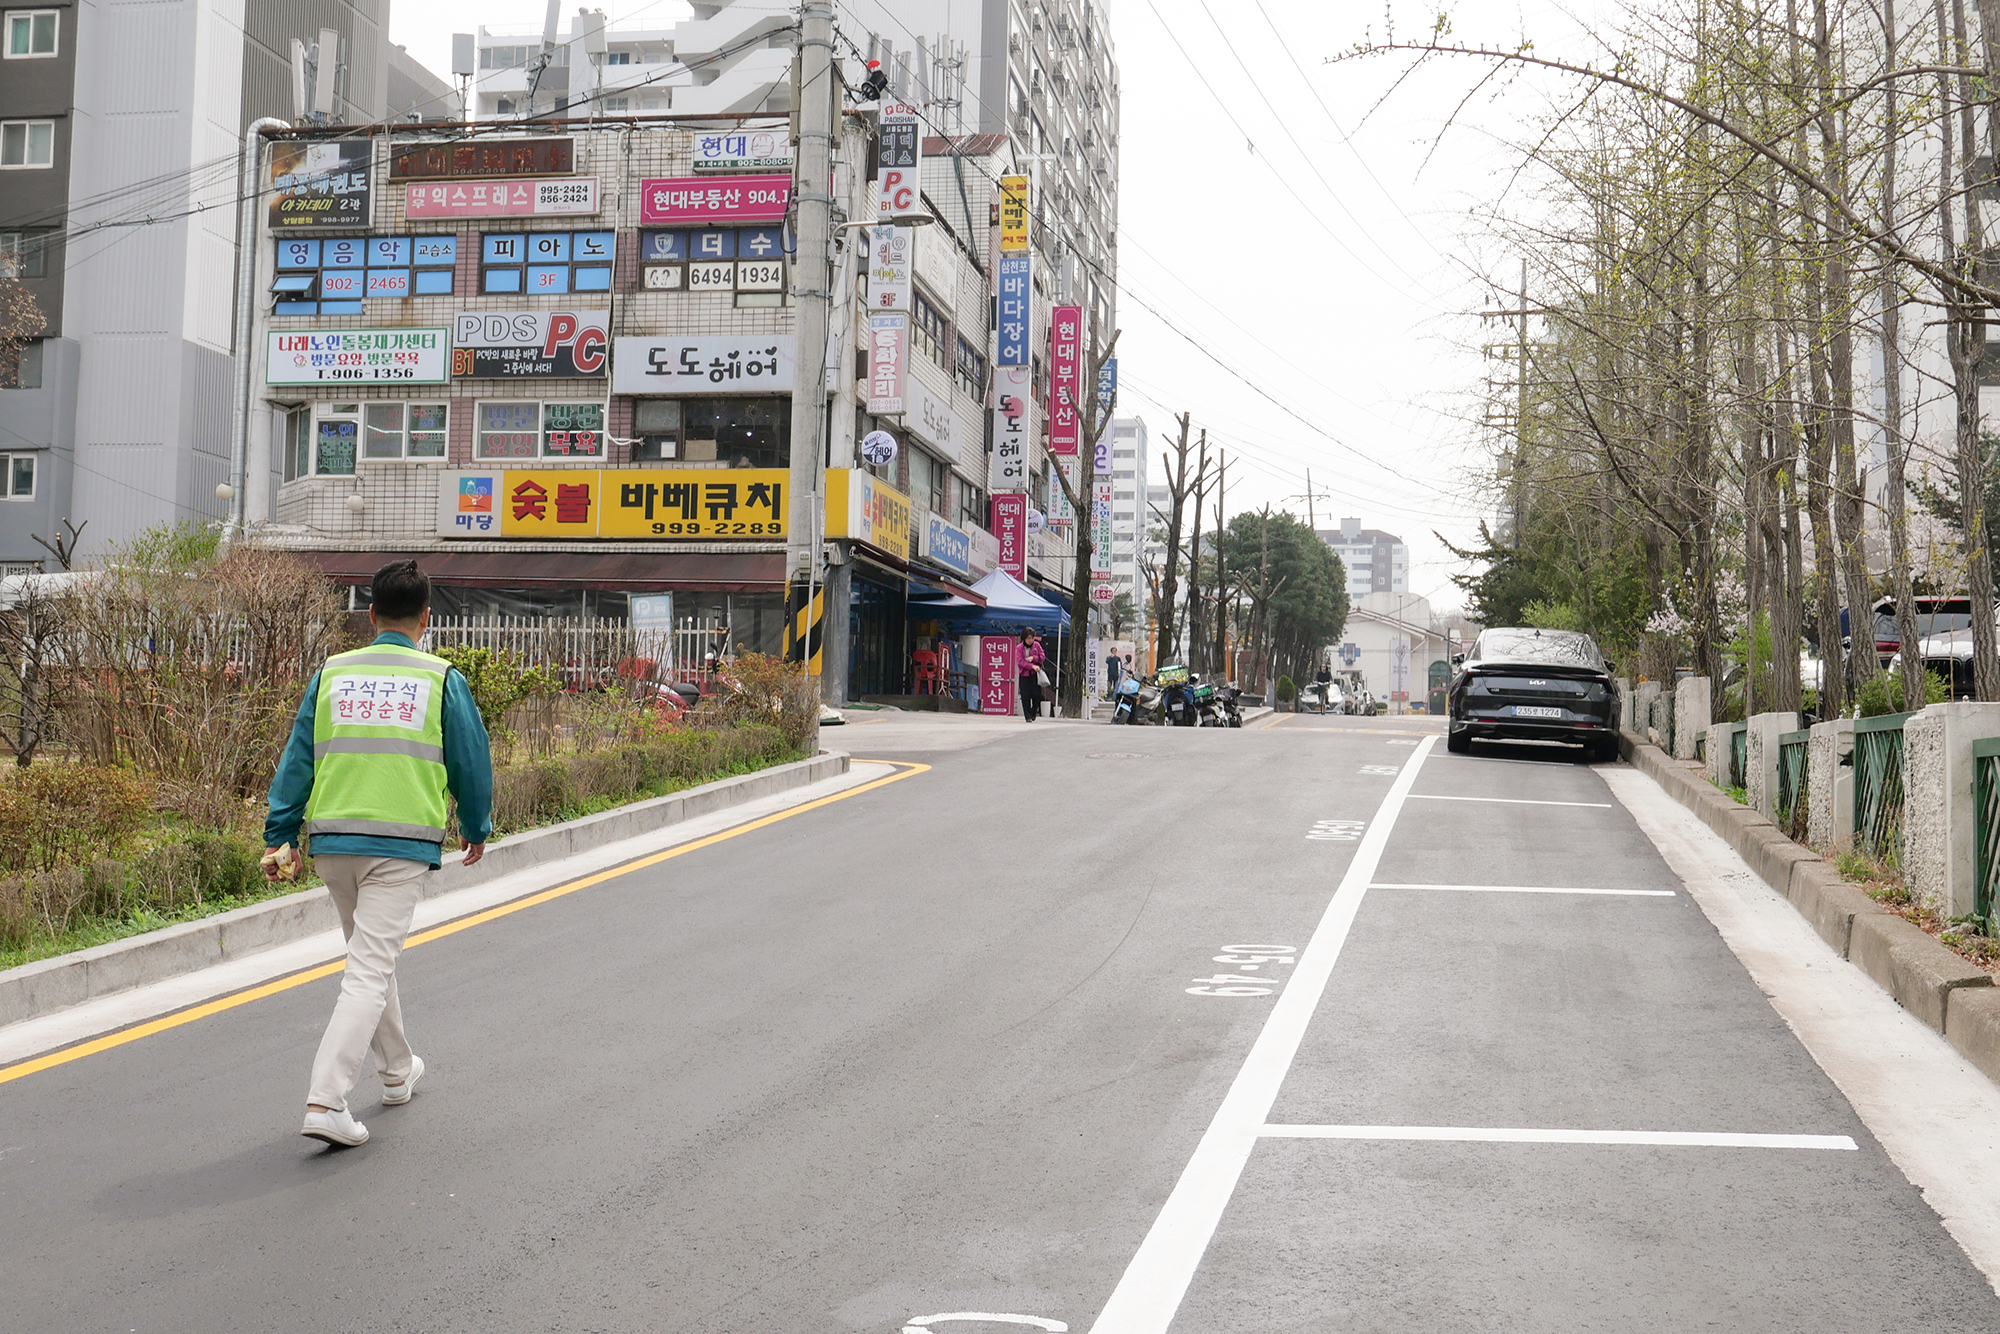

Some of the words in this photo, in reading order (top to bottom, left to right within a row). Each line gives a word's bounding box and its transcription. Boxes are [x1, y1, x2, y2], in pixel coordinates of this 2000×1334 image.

[700, 136, 746, 157] 현대
[432, 186, 528, 208] 익스프레스
[540, 186, 588, 194] 995-2424
[540, 194, 588, 203] 956-2424
[882, 171, 913, 210] PC
[281, 199, 333, 211] 아카데미
[340, 199, 361, 210] 2관
[653, 189, 741, 211] 현대부동산
[881, 201, 891, 211] B1
[873, 226, 893, 240] 연세
[418, 244, 453, 257] 교습소
[878, 242, 906, 266] 위드
[691, 268, 732, 284] 6494
[740, 267, 780, 283] 1934
[873, 267, 906, 282] 피아노
[1001, 261, 1028, 274] 삼천포
[539, 274, 557, 286] 3F
[881, 292, 896, 307] 3F
[1003, 278, 1024, 364] 바다장어
[278, 333, 436, 351] 나래노인돌봄재가센터
[457, 315, 537, 342] PDS
[542, 312, 607, 373] PC
[452, 349, 474, 375] B1
[476, 350, 499, 361] PC방의
[501, 349, 521, 360] 새로운
[523, 349, 538, 360] 바람
[315, 368, 414, 379] T.906-1356
[503, 364, 510, 374] 그
[512, 362, 533, 374] 중심에
[534, 362, 552, 373] 서다!
[645, 346, 778, 383] 도도헤어
[1056, 321, 1075, 427] 현대부동산
[487, 406, 534, 429] 방문
[551, 405, 599, 429] 방문
[322, 424, 354, 438] 노인
[997, 394, 1023, 477] 도도헤어
[485, 432, 534, 456] 요양
[548, 431, 598, 455] 목욕
[875, 446, 893, 456] 헤어
[1095, 444, 1107, 469] CU
[511, 479, 591, 523] 숯불
[998, 503, 1020, 515] 현대
[455, 515, 493, 530] 마당
[651, 523, 782, 535] 999-2289
[1002, 517, 1015, 561] 부동산
[986, 643, 1008, 653] 현대
[987, 656, 1005, 705] 부동산
[339, 680, 418, 701] 구석구석
[338, 699, 417, 722] 현장순찰
[1540, 709, 1560, 717] 1274
